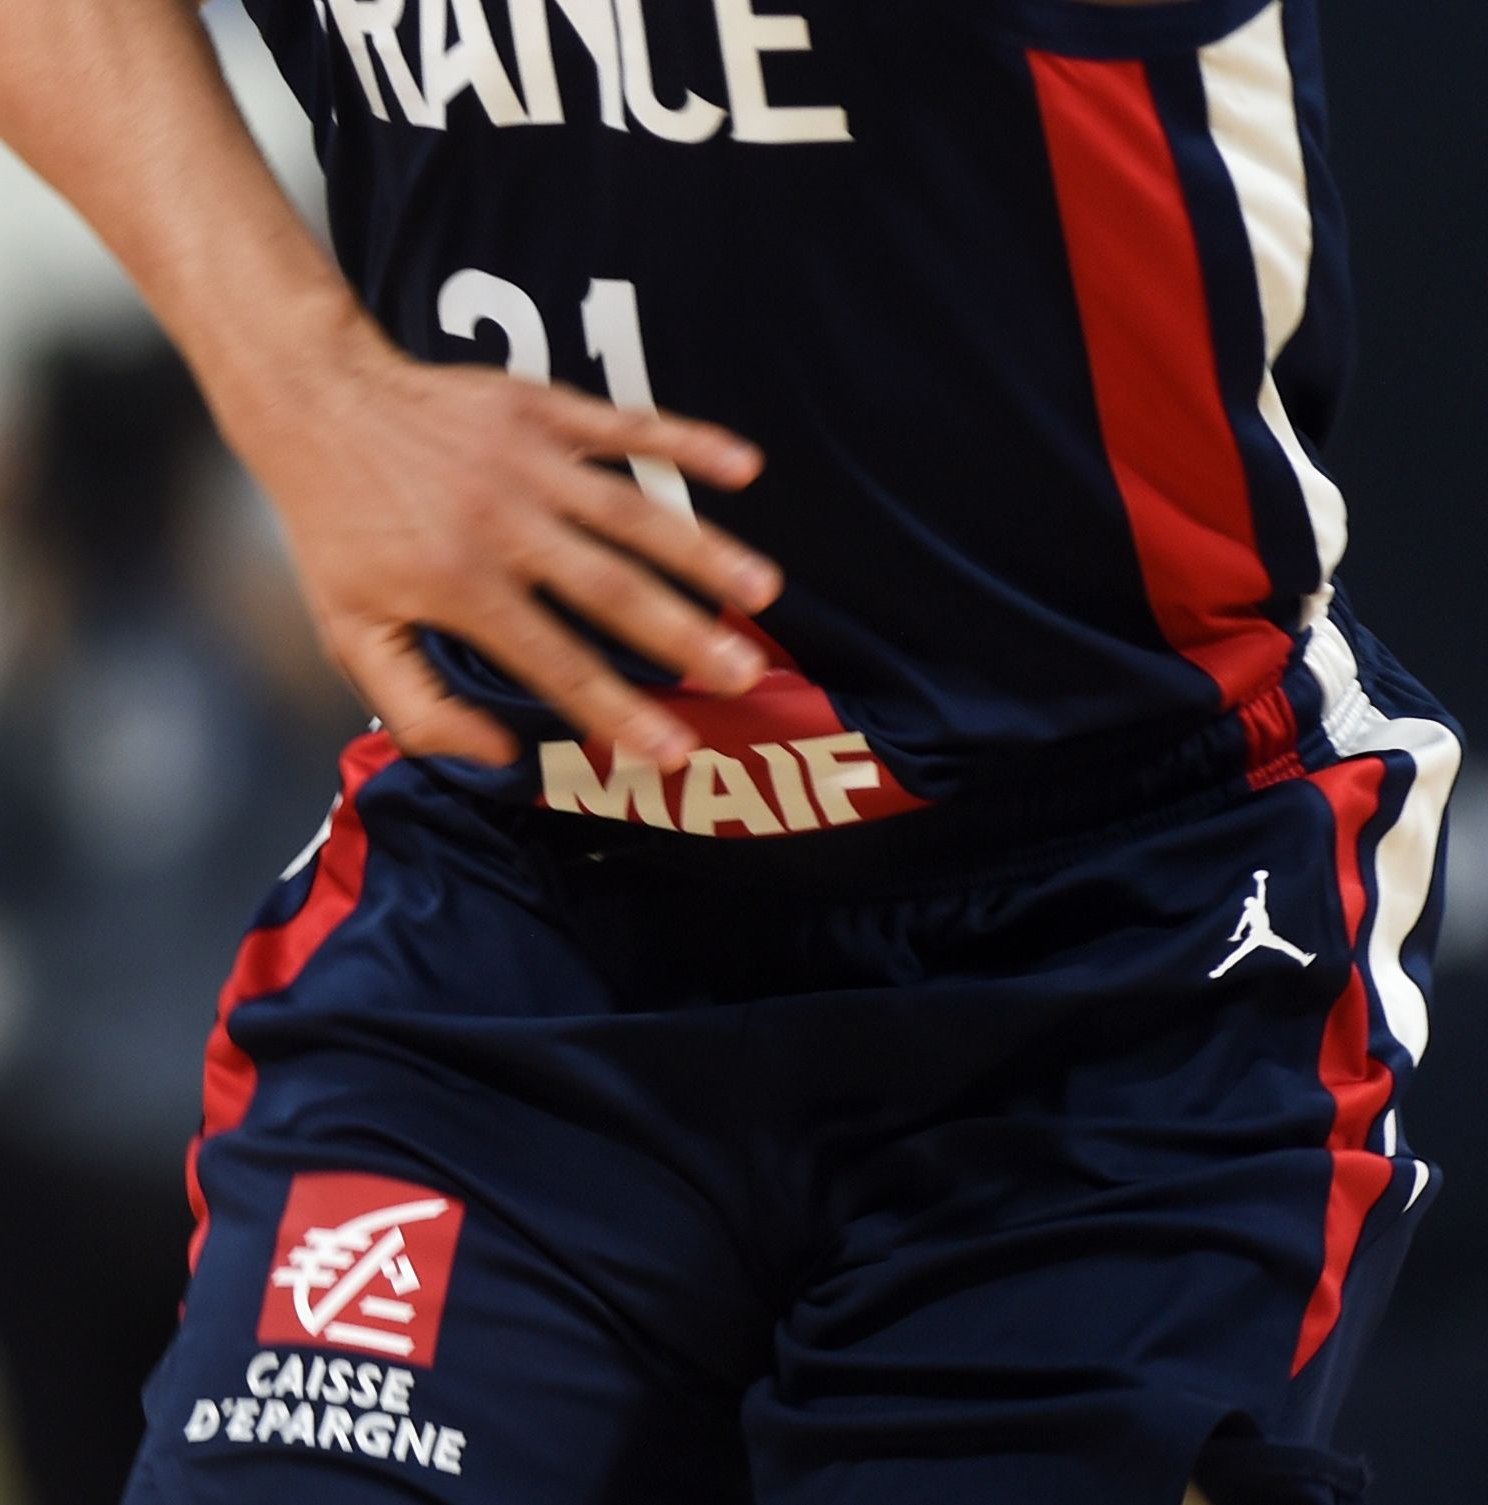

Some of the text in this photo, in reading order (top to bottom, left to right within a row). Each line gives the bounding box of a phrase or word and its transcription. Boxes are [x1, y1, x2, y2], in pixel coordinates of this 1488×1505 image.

[538, 730, 882, 837] MAIF
[245, 1349, 416, 1416] CAISSE
[182, 1396, 468, 1477] D'EPARGNE
